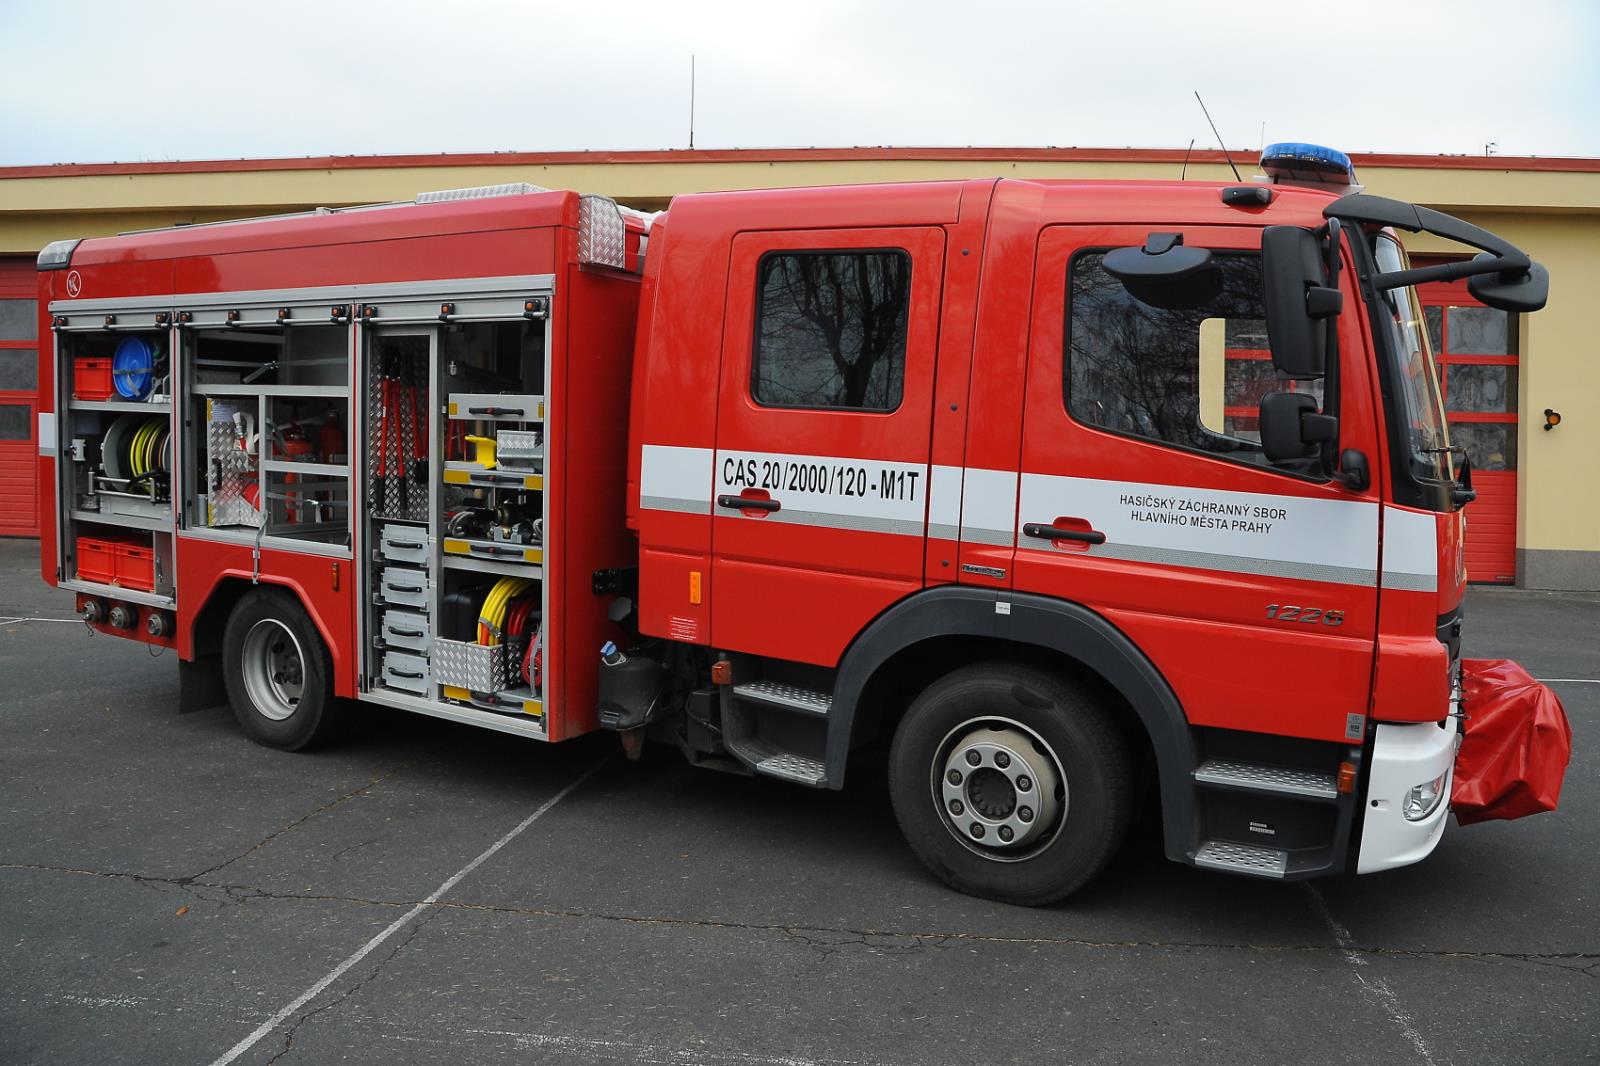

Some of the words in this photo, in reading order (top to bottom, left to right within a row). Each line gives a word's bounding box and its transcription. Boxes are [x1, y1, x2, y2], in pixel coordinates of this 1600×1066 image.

[723, 458, 757, 487] CAS
[880, 469, 919, 501] M1T
[1120, 494, 1176, 510] HASIČSKÝ
[1178, 497, 1250, 517] ZÁCHRANNÝ
[1253, 506, 1287, 520] SBOR
[1131, 510, 1187, 526] HLAVNÍHO
[1190, 515, 1228, 530] MĚSTA
[1231, 520, 1272, 534] PRAHY
[1265, 604, 1345, 627] 1226
